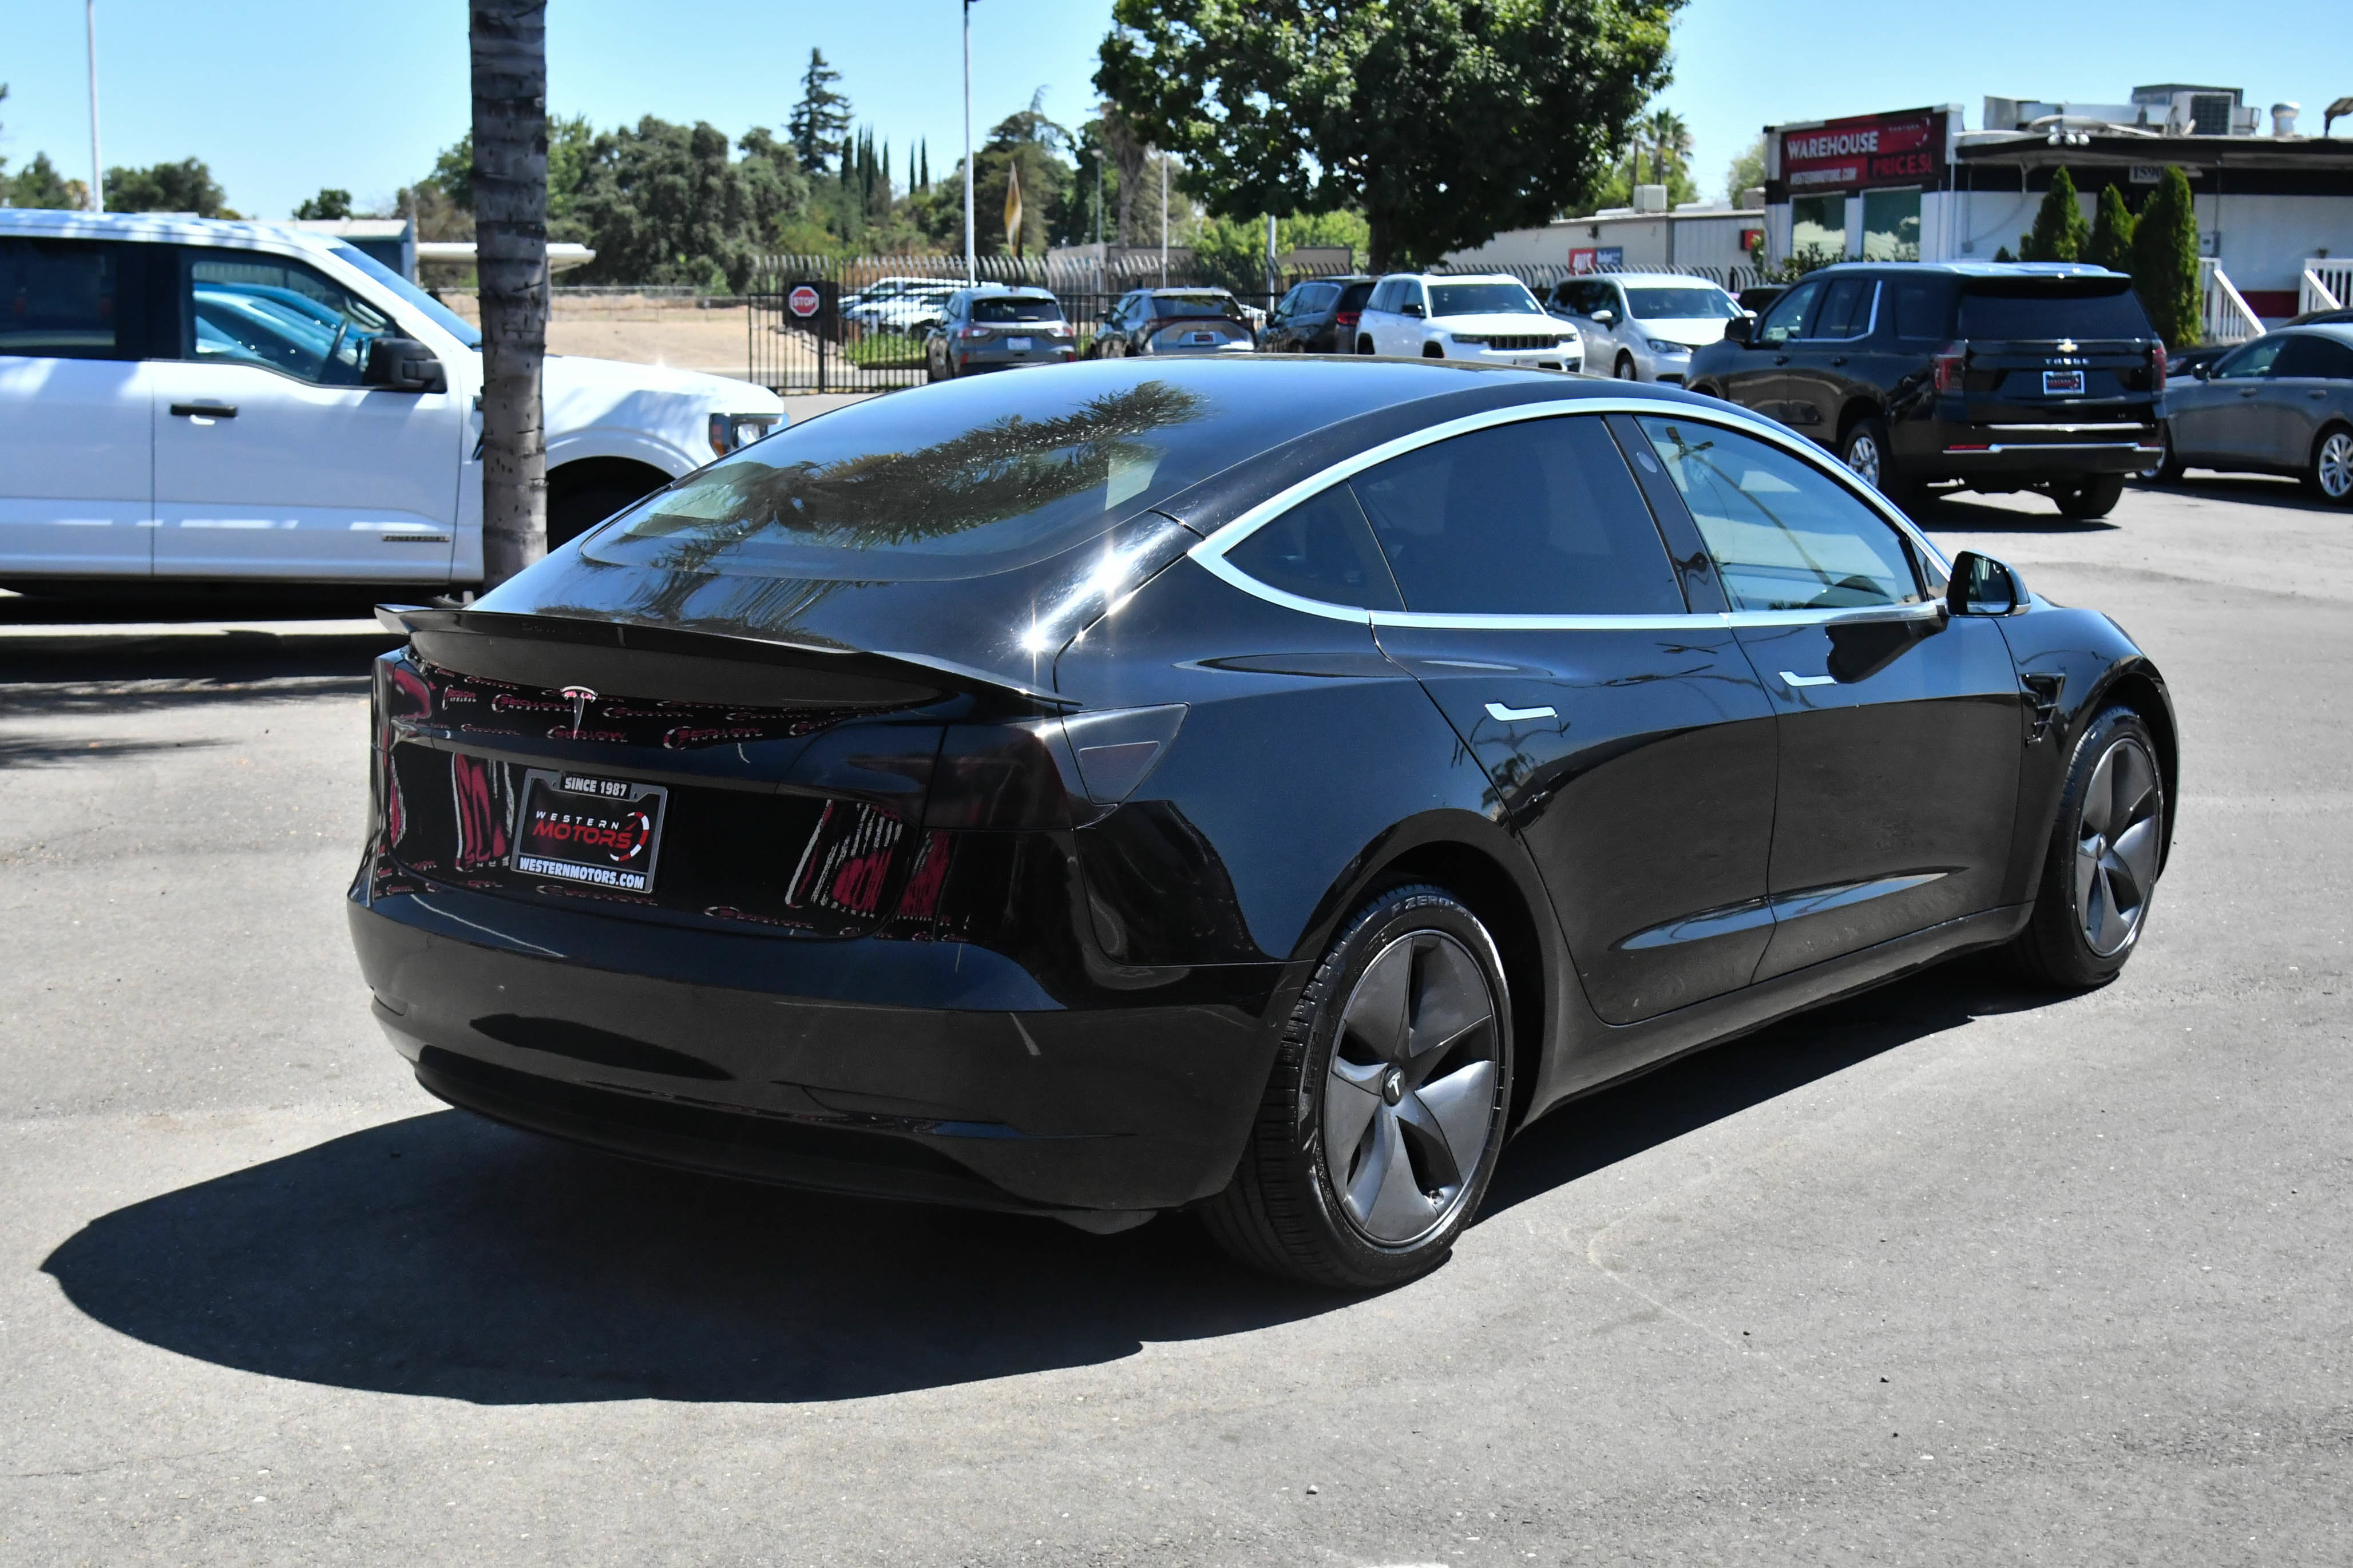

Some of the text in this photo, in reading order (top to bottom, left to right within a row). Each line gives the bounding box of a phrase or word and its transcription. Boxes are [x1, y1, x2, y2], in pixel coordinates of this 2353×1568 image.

[1788, 131, 1879, 160] WAREHOUSE
[793, 296, 816, 307] STOP
[564, 777, 627, 797] SINCE 1987
[536, 811, 619, 830] WESTERN
[533, 820, 633, 849] MOTORS
[520, 857, 645, 890] WESTERNMOTORS.COM
